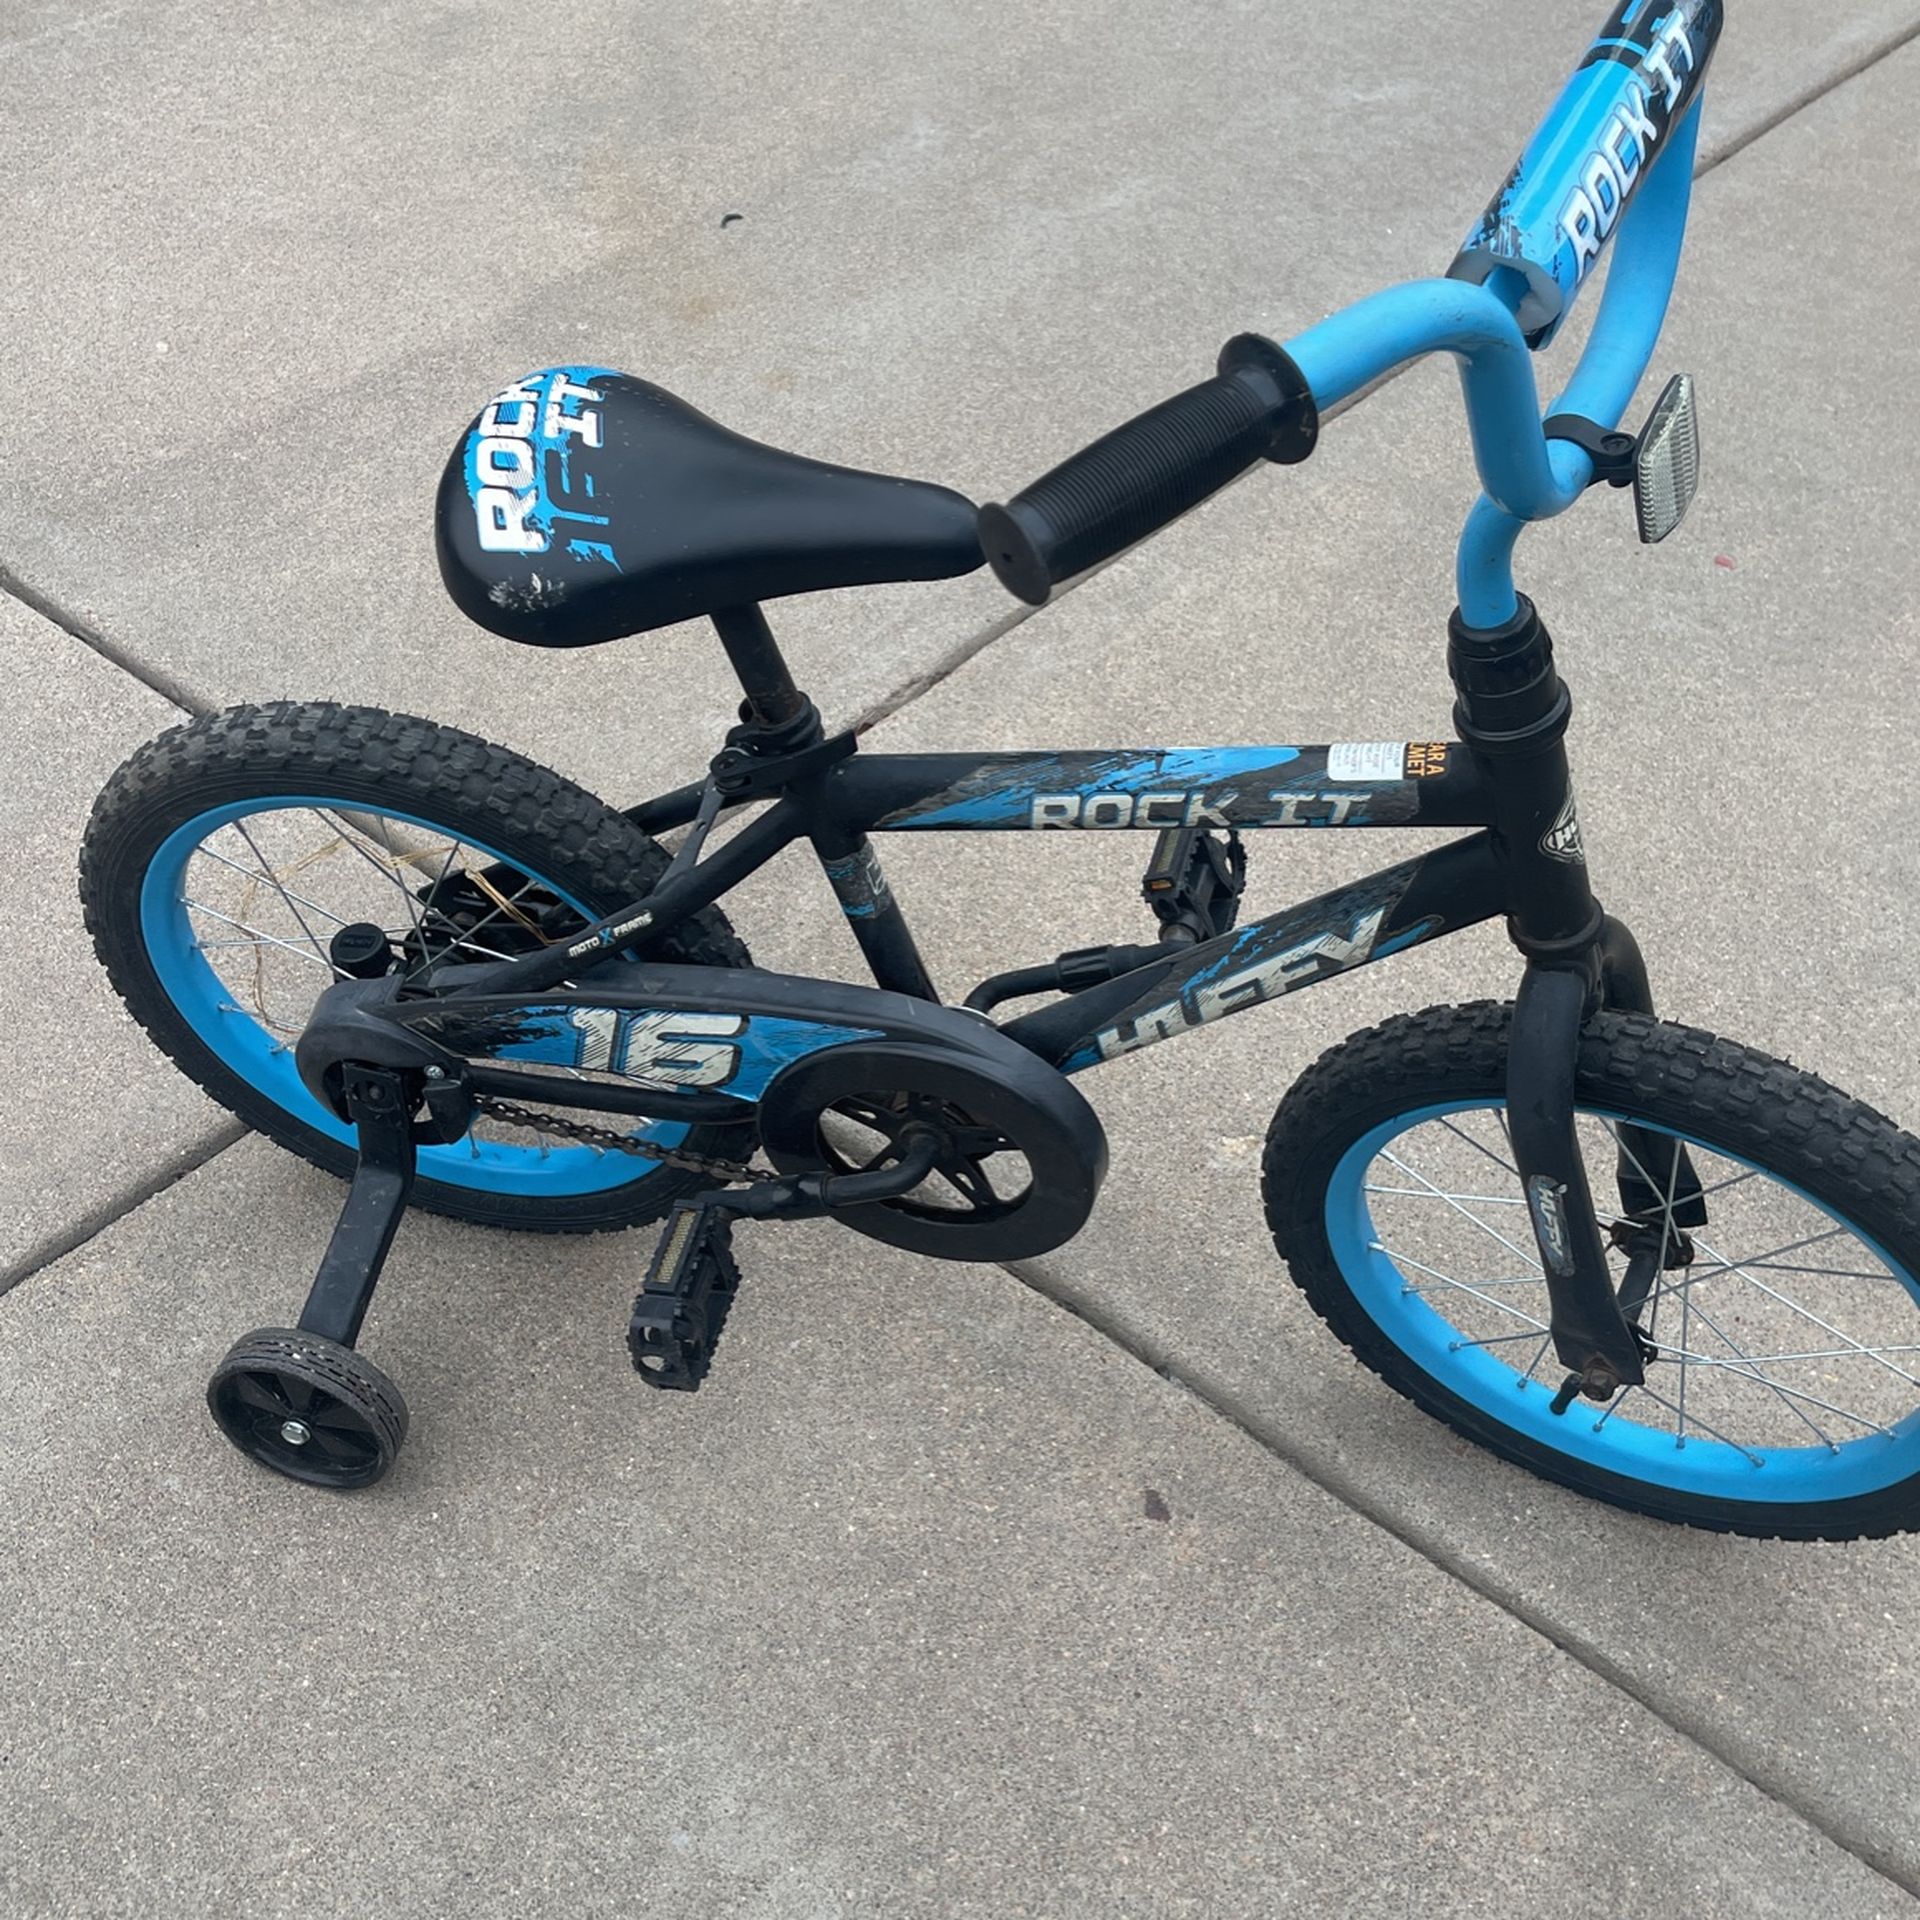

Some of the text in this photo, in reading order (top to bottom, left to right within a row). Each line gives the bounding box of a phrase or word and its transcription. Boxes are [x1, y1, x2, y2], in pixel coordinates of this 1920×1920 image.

[1557, 7, 1695, 285] ROCK IT
[544, 372, 604, 449] IT
[477, 374, 551, 553] ROCK
[1426, 764, 1445, 775] A
[1031, 790, 1372, 830] ROCK IT
[568, 936, 601, 958] MOTO
[613, 910, 654, 937] FRAME
[567, 1006, 749, 1088] 16
